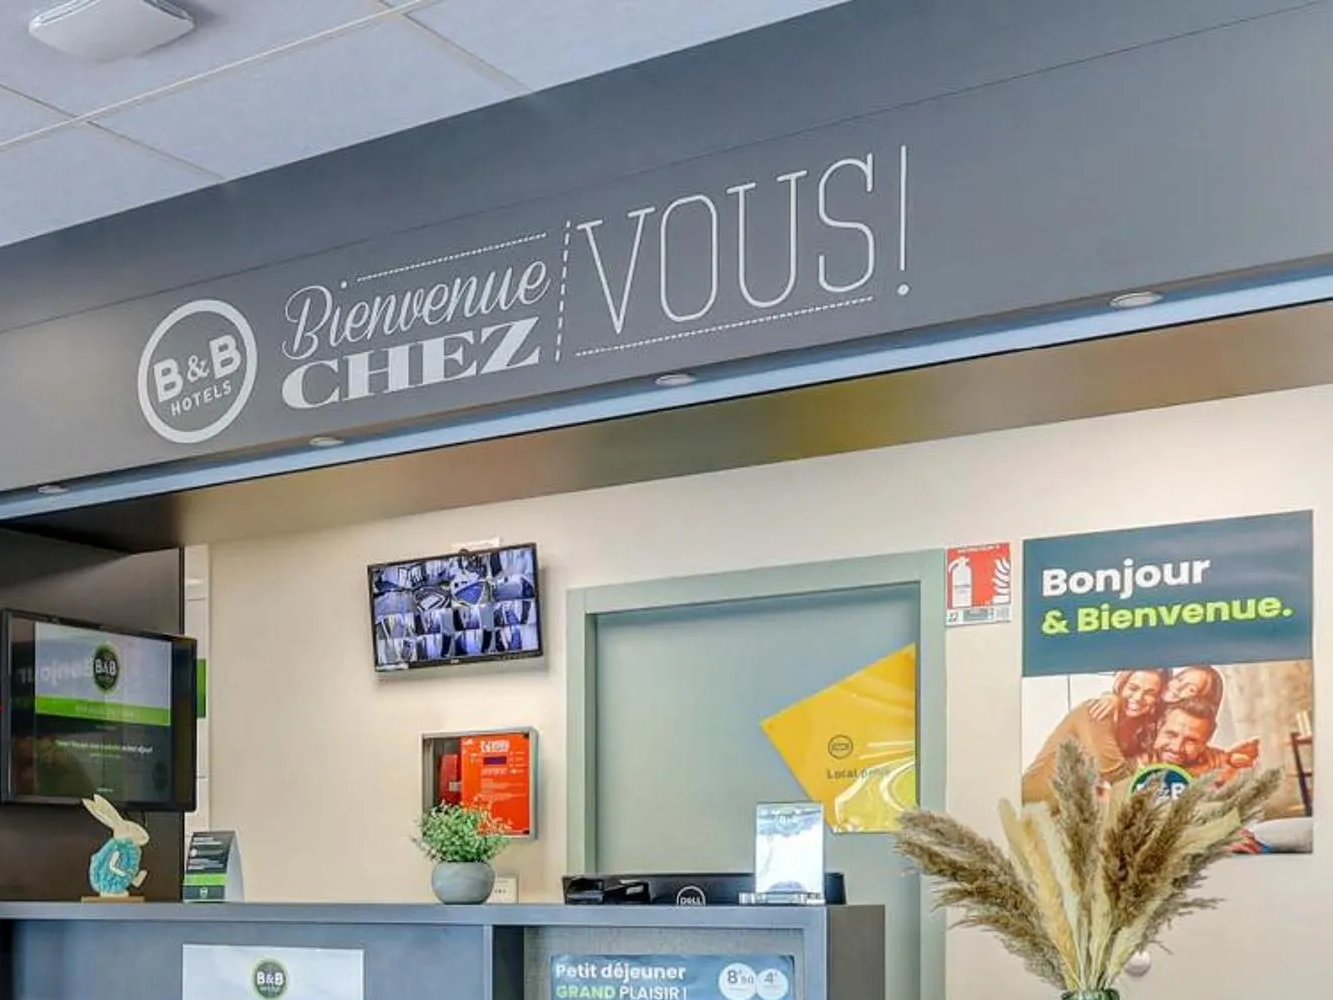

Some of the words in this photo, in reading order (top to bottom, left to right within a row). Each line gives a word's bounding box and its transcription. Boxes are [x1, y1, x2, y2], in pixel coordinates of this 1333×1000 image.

[576, 145, 910, 334] VOUS!
[282, 260, 552, 360] Bienvenue
[153, 334, 241, 402] B&B
[281, 316, 541, 409] CHEZ
[170, 380, 232, 416] HOTELS
[1041, 557, 1211, 600] Bonjour
[1041, 610, 1069, 636] &
[1077, 596, 1294, 633] Bienvenue.
[256, 971, 284, 986] B&B
[555, 963, 598, 979] Petit
[601, 961, 687, 984] déjeuner
[556, 984, 616, 999] GRAND
